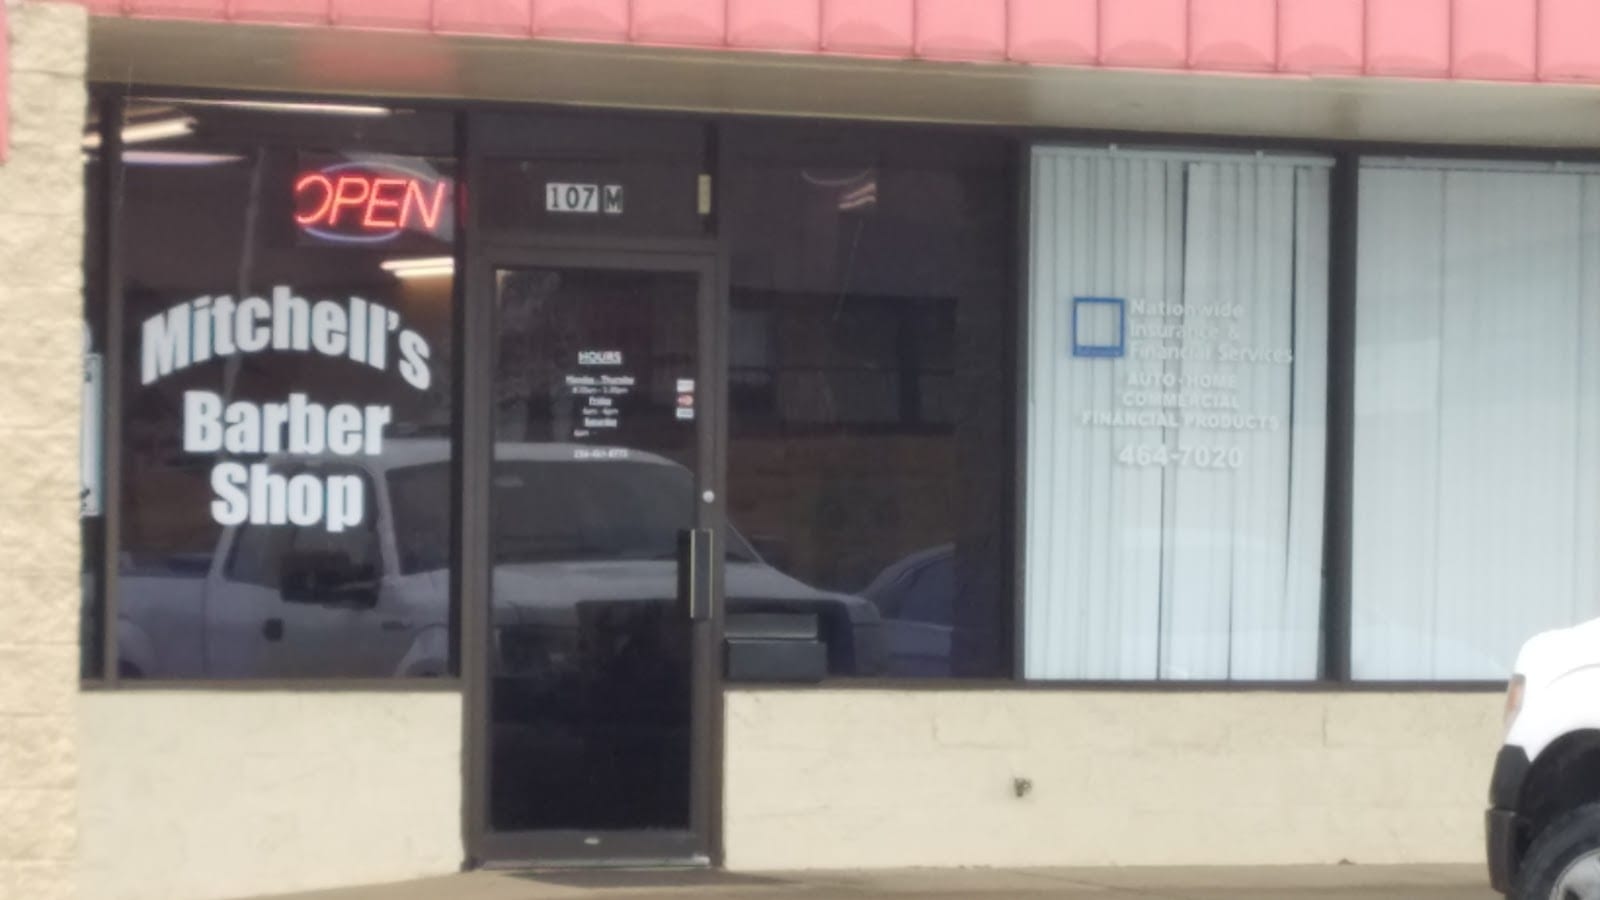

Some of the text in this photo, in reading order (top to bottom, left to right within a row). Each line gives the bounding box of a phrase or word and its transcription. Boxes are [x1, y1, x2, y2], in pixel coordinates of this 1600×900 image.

[295, 174, 446, 229] OPEN
[548, 185, 622, 213] 107 M
[141, 286, 432, 391] Mitchell's
[578, 351, 622, 365] HOURS
[1217, 344, 1293, 364] Services
[1122, 392, 1240, 409] COMMERCIAL
[183, 390, 392, 456] Barber
[1081, 411, 1280, 431] FINANCIAL PRODUCTS
[1119, 445, 1244, 469] 464-7020
[210, 461, 364, 533] Shop
